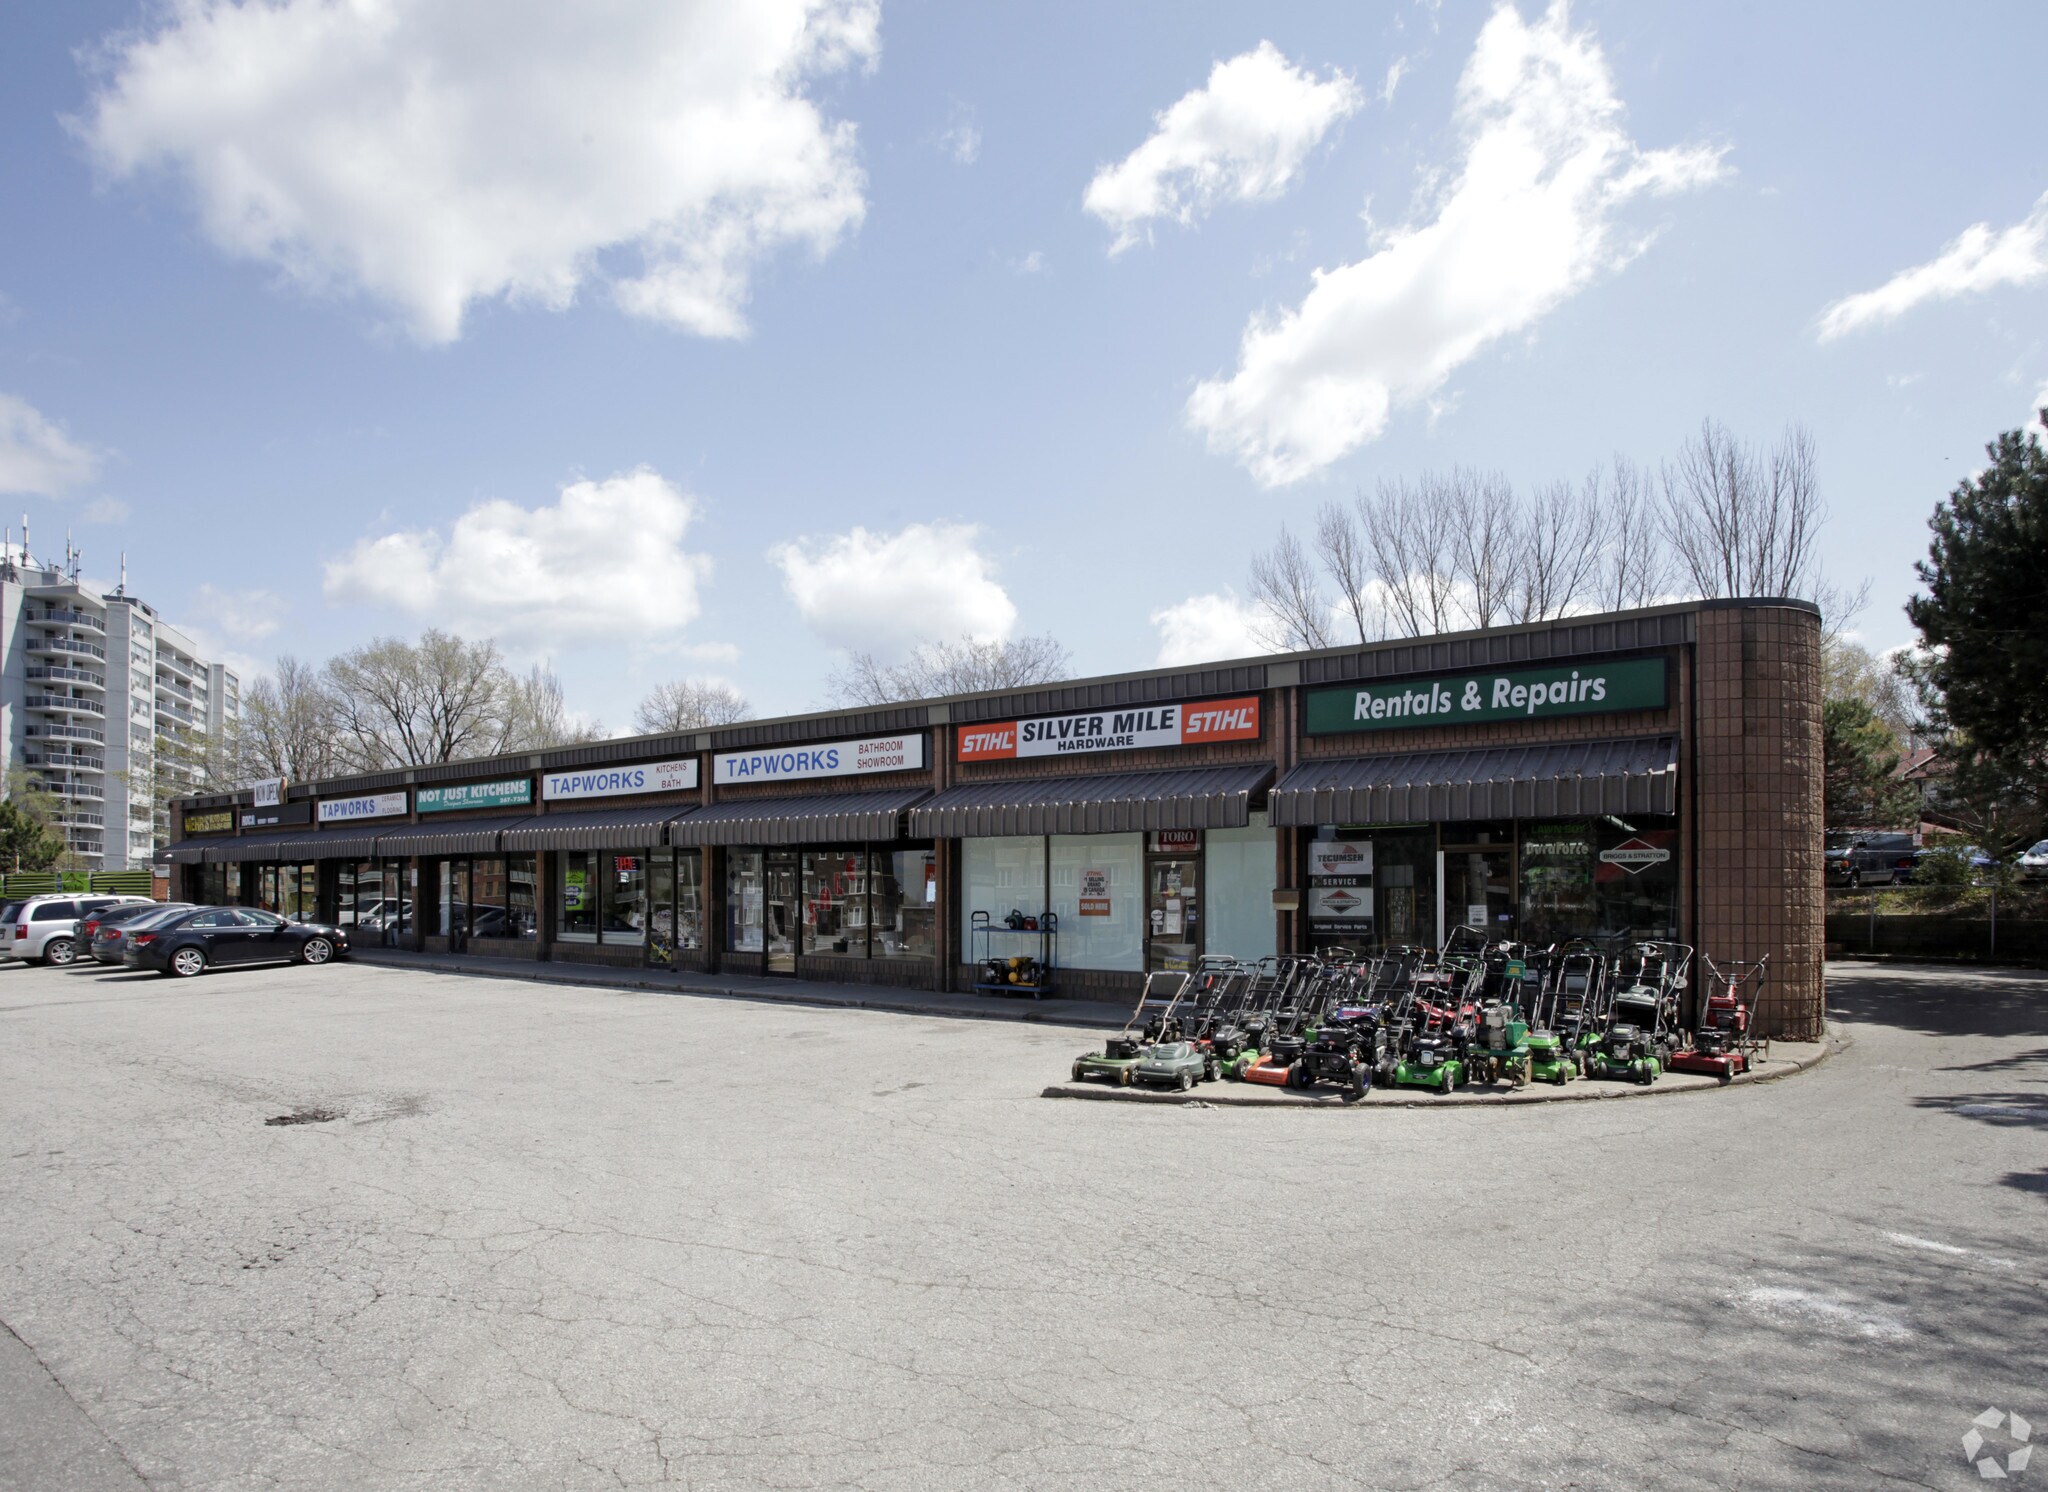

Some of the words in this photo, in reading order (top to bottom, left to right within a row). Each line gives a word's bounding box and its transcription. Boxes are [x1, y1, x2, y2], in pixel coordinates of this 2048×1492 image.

[1354, 683, 1451, 720] Rentals
[1461, 681, 1481, 711] &
[1491, 671, 1606, 714] Repairs
[1022, 716, 1103, 742] SILVER
[1113, 709, 1175, 734] MILE
[1186, 707, 1254, 734] STIHL
[859, 740, 903, 754] BATHROOM
[962, 731, 1014, 754] STIHL
[1058, 735, 1134, 752] HARDWARE
[656, 762, 687, 774] KITCHENS
[727, 749, 839, 777] TAPWORKS
[857, 755, 904, 769] SHOWROOM
[552, 770, 644, 794] TAPWORKS
[661, 779, 681, 789] BATH
[255, 786, 266, 803] NOW
[418, 789, 440, 803] NOT
[443, 787, 467, 801] JUST
[471, 781, 526, 798] KITCHENS
[323, 799, 375, 817] TAPWORKS
[1162, 831, 1194, 842] TORO
[1317, 854, 1363, 862] TECUMSEH
[1323, 878, 1357, 886] SERVICE
